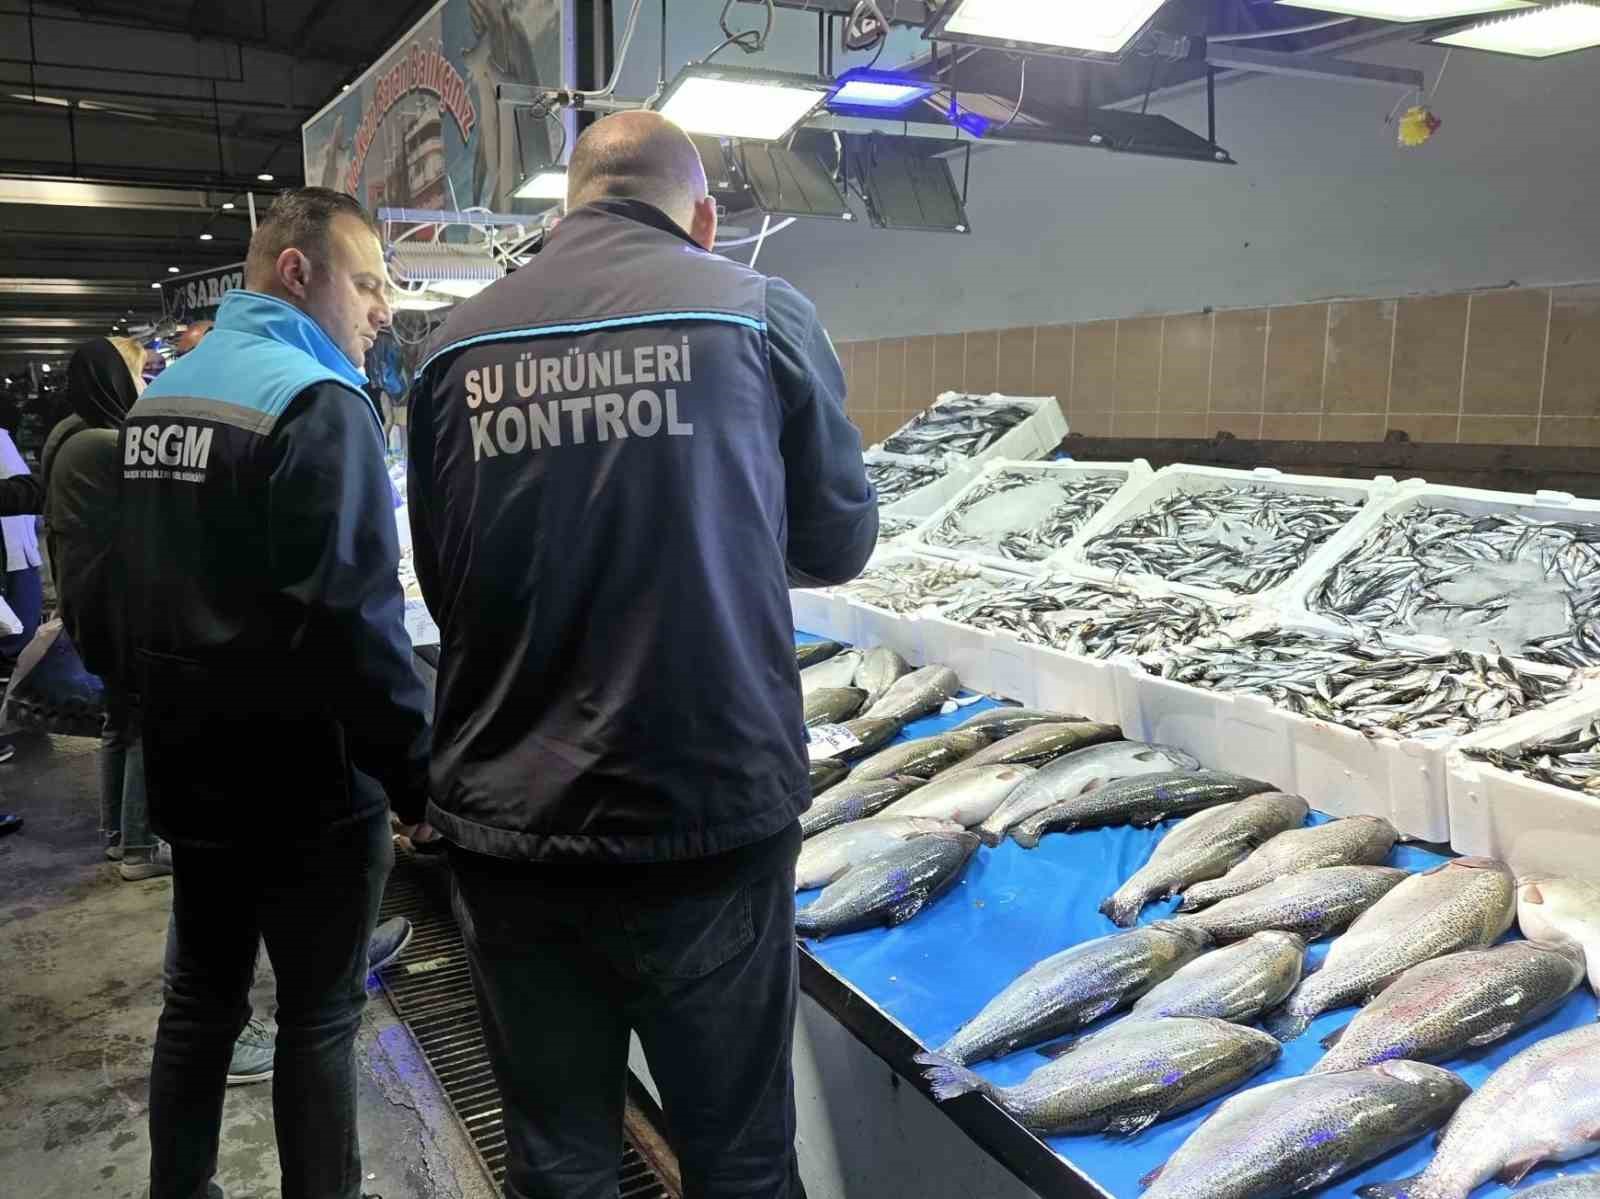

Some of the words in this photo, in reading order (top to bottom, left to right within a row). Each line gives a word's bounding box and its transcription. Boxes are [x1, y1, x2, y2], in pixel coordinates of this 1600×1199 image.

[465, 363, 504, 409] SU
[515, 336, 692, 398] ÜRÜNLERİ
[124, 424, 214, 469] BSGM
[470, 389, 694, 463] KONTROL
